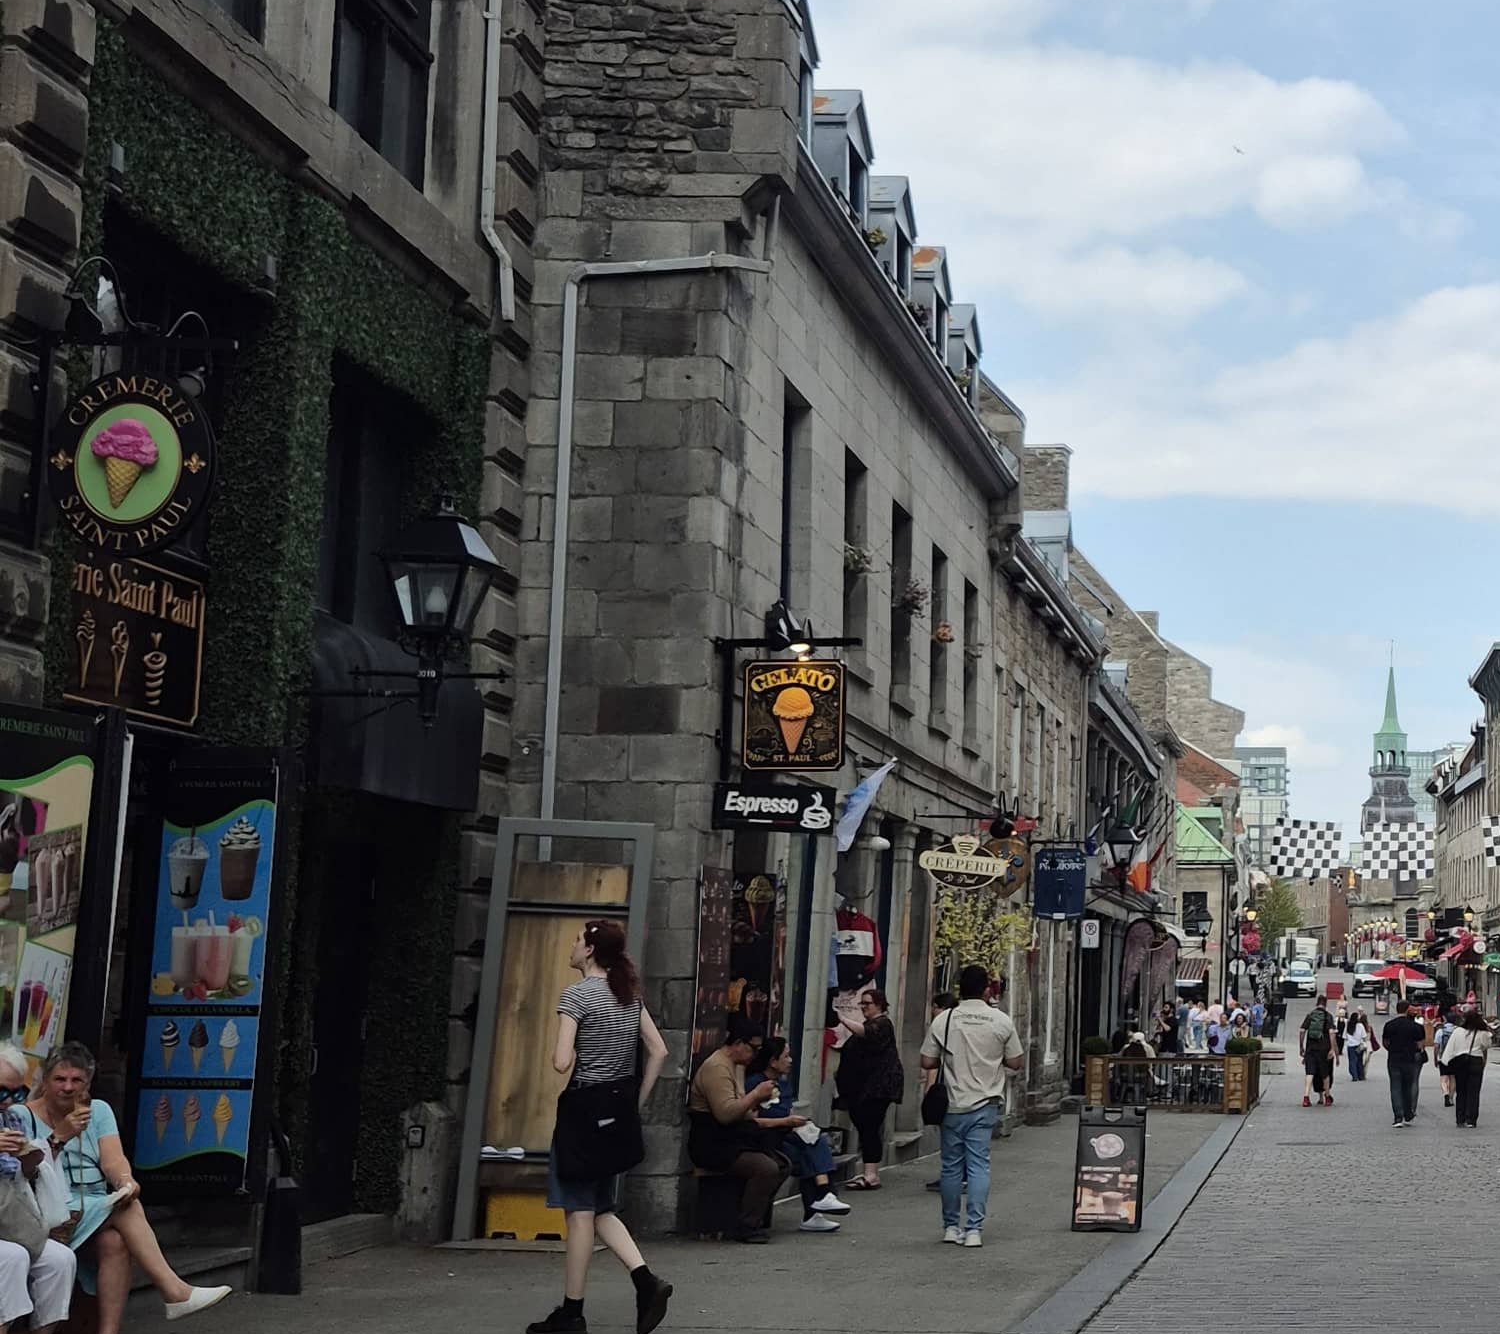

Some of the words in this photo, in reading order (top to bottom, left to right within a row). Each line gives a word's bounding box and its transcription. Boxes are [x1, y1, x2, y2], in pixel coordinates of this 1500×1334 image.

[68, 376, 195, 428] CREMERIE
[60, 494, 128, 551] SAINT
[135, 497, 193, 548] PAUL
[107, 562, 157, 615] Saint
[160, 581, 198, 629] Paul
[751, 668, 836, 693] GELATO
[772, 753, 786, 763] ST.
[788, 753, 813, 763] PAUL
[724, 790, 799, 816] Espresso
